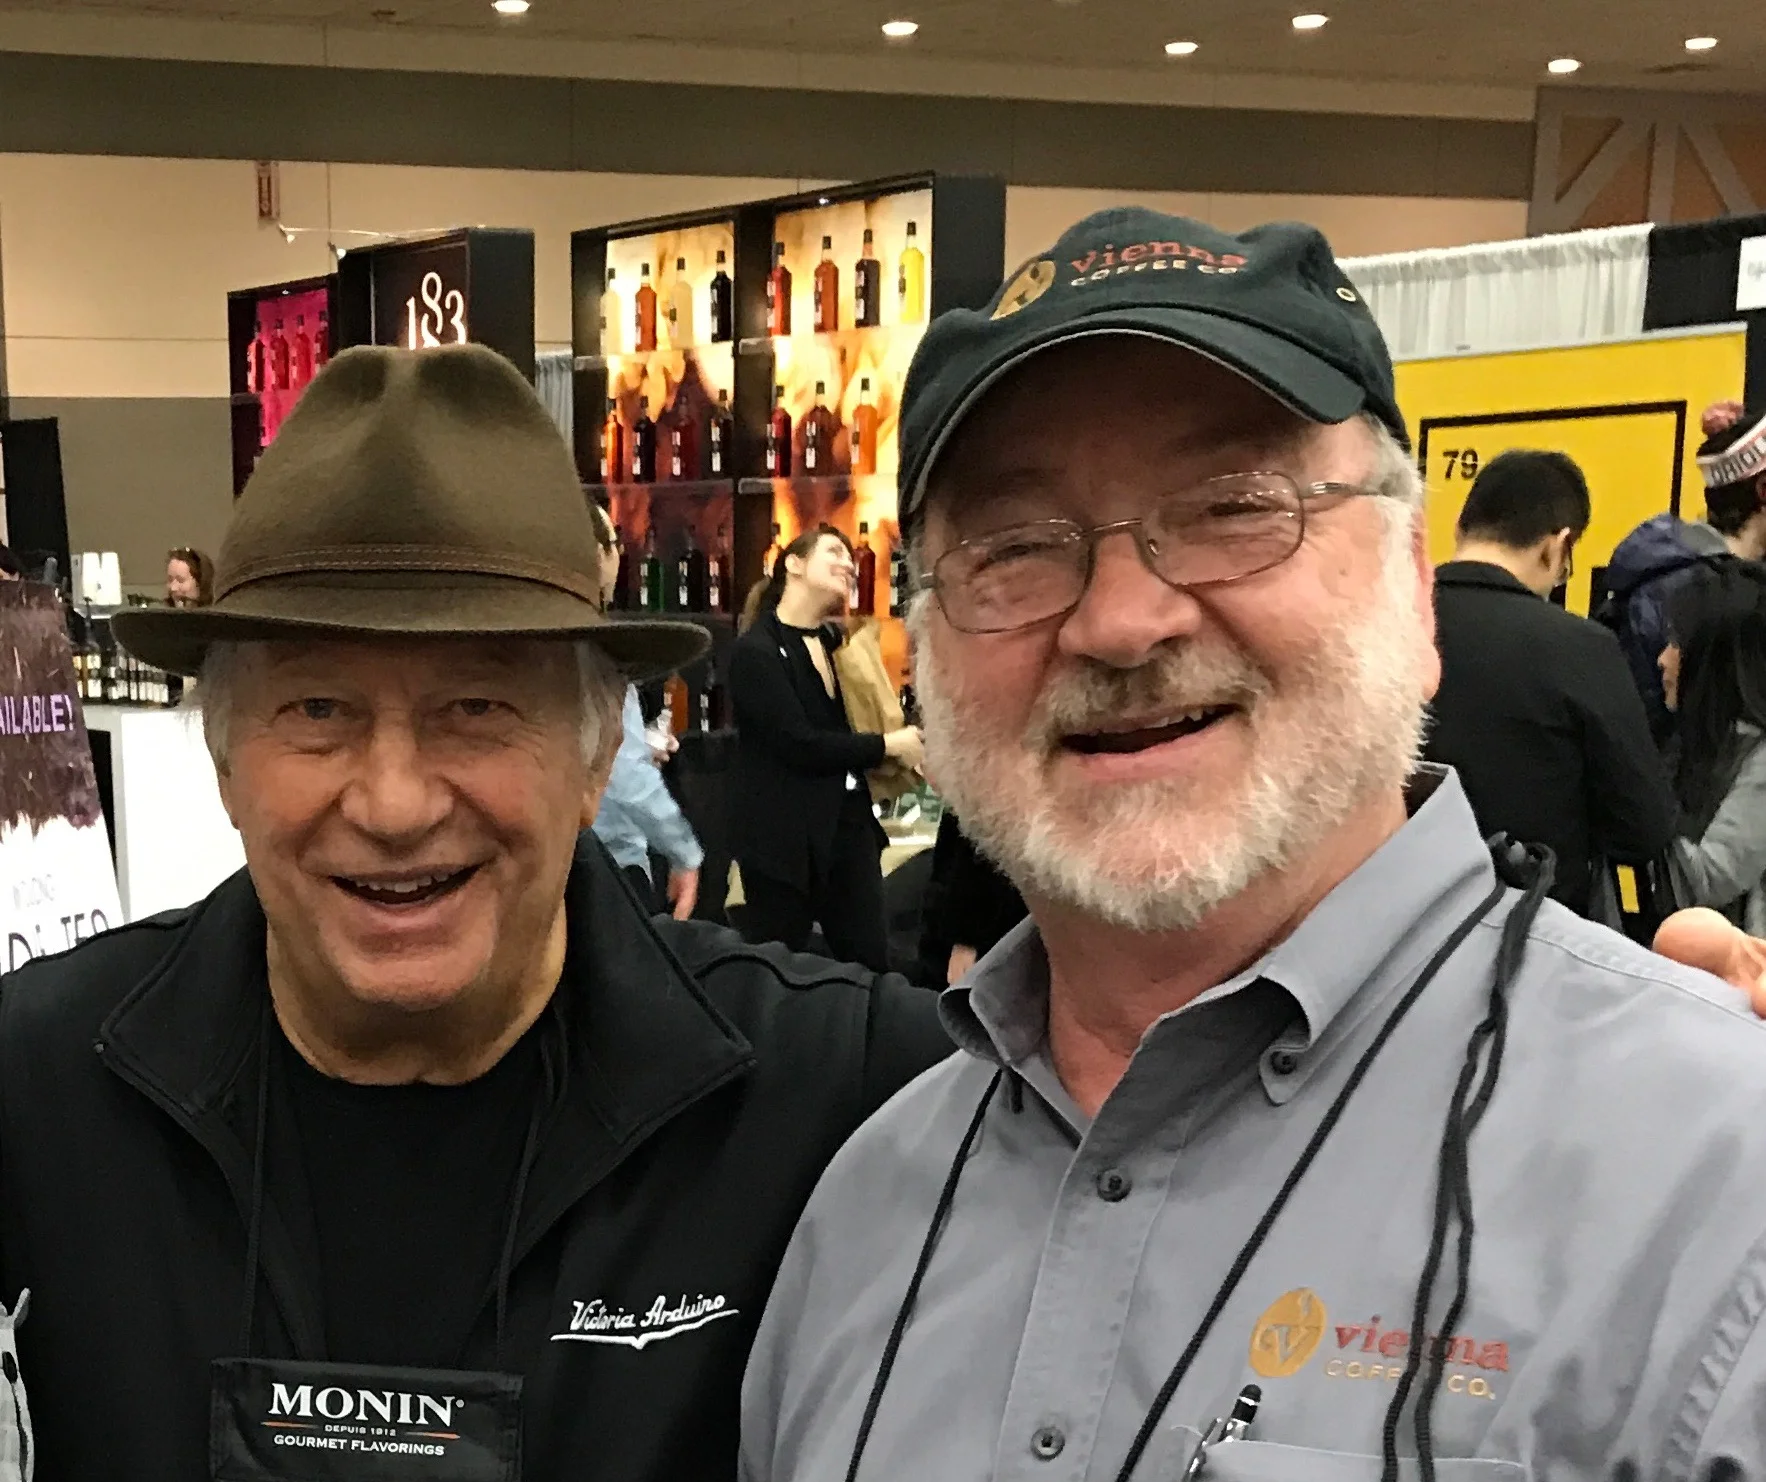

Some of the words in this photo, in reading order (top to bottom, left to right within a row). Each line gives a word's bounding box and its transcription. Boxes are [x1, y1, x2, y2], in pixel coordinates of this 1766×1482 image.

[1071, 241, 1248, 274] vienna
[640, 1293, 726, 1328] Arduino
[273, 1434, 348, 1451] GOURMET
[351, 1440, 445, 1456] FLAVORINGS
